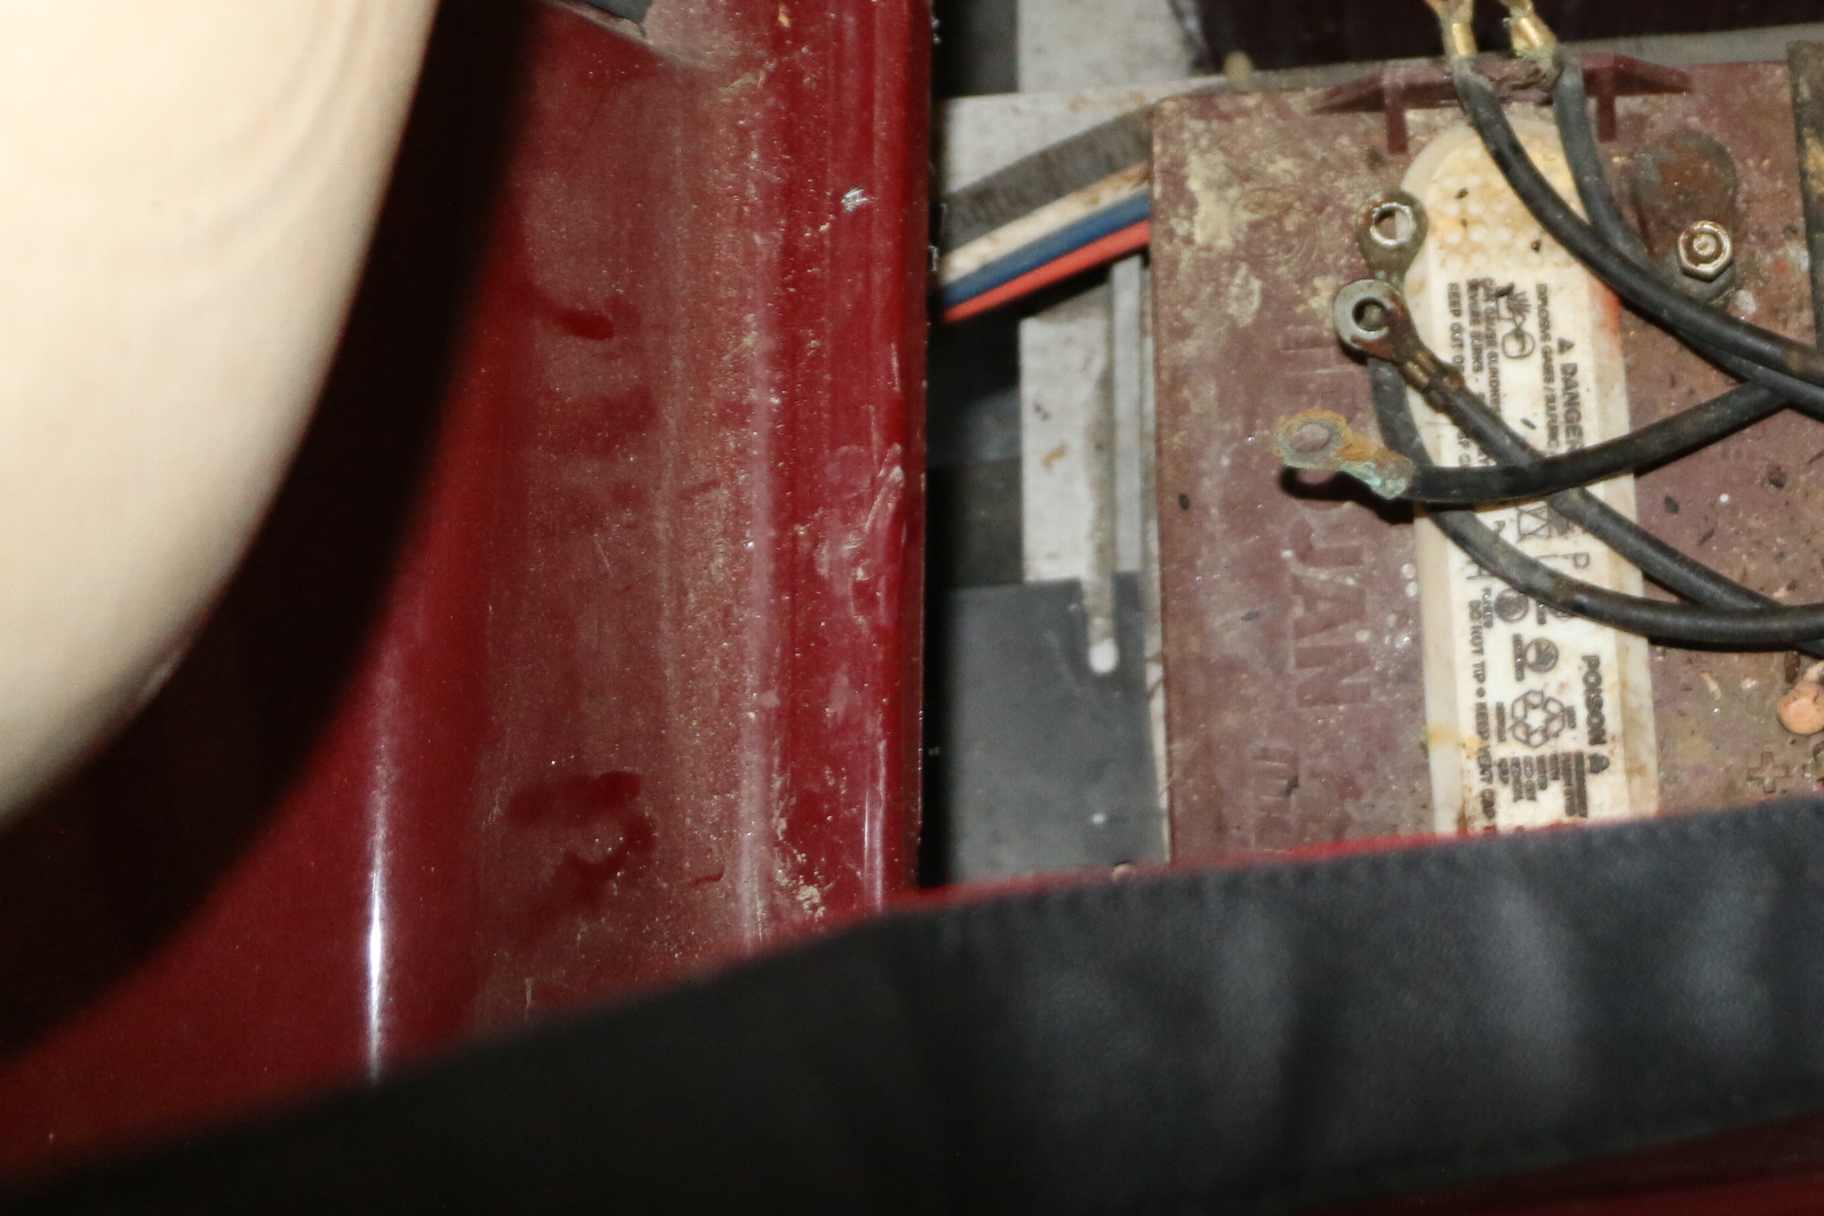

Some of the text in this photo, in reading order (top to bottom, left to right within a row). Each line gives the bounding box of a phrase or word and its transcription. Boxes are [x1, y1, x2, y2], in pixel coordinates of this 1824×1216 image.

[1450, 323, 1464, 349] OUT
[1471, 600, 1482, 620] DO
[1471, 626, 1483, 654] NOT
[1473, 662, 1486, 683] TIP
[1581, 655, 1608, 746] POISON
[1475, 702, 1489, 740] KEEP
[1482, 789, 1495, 819] CAP
